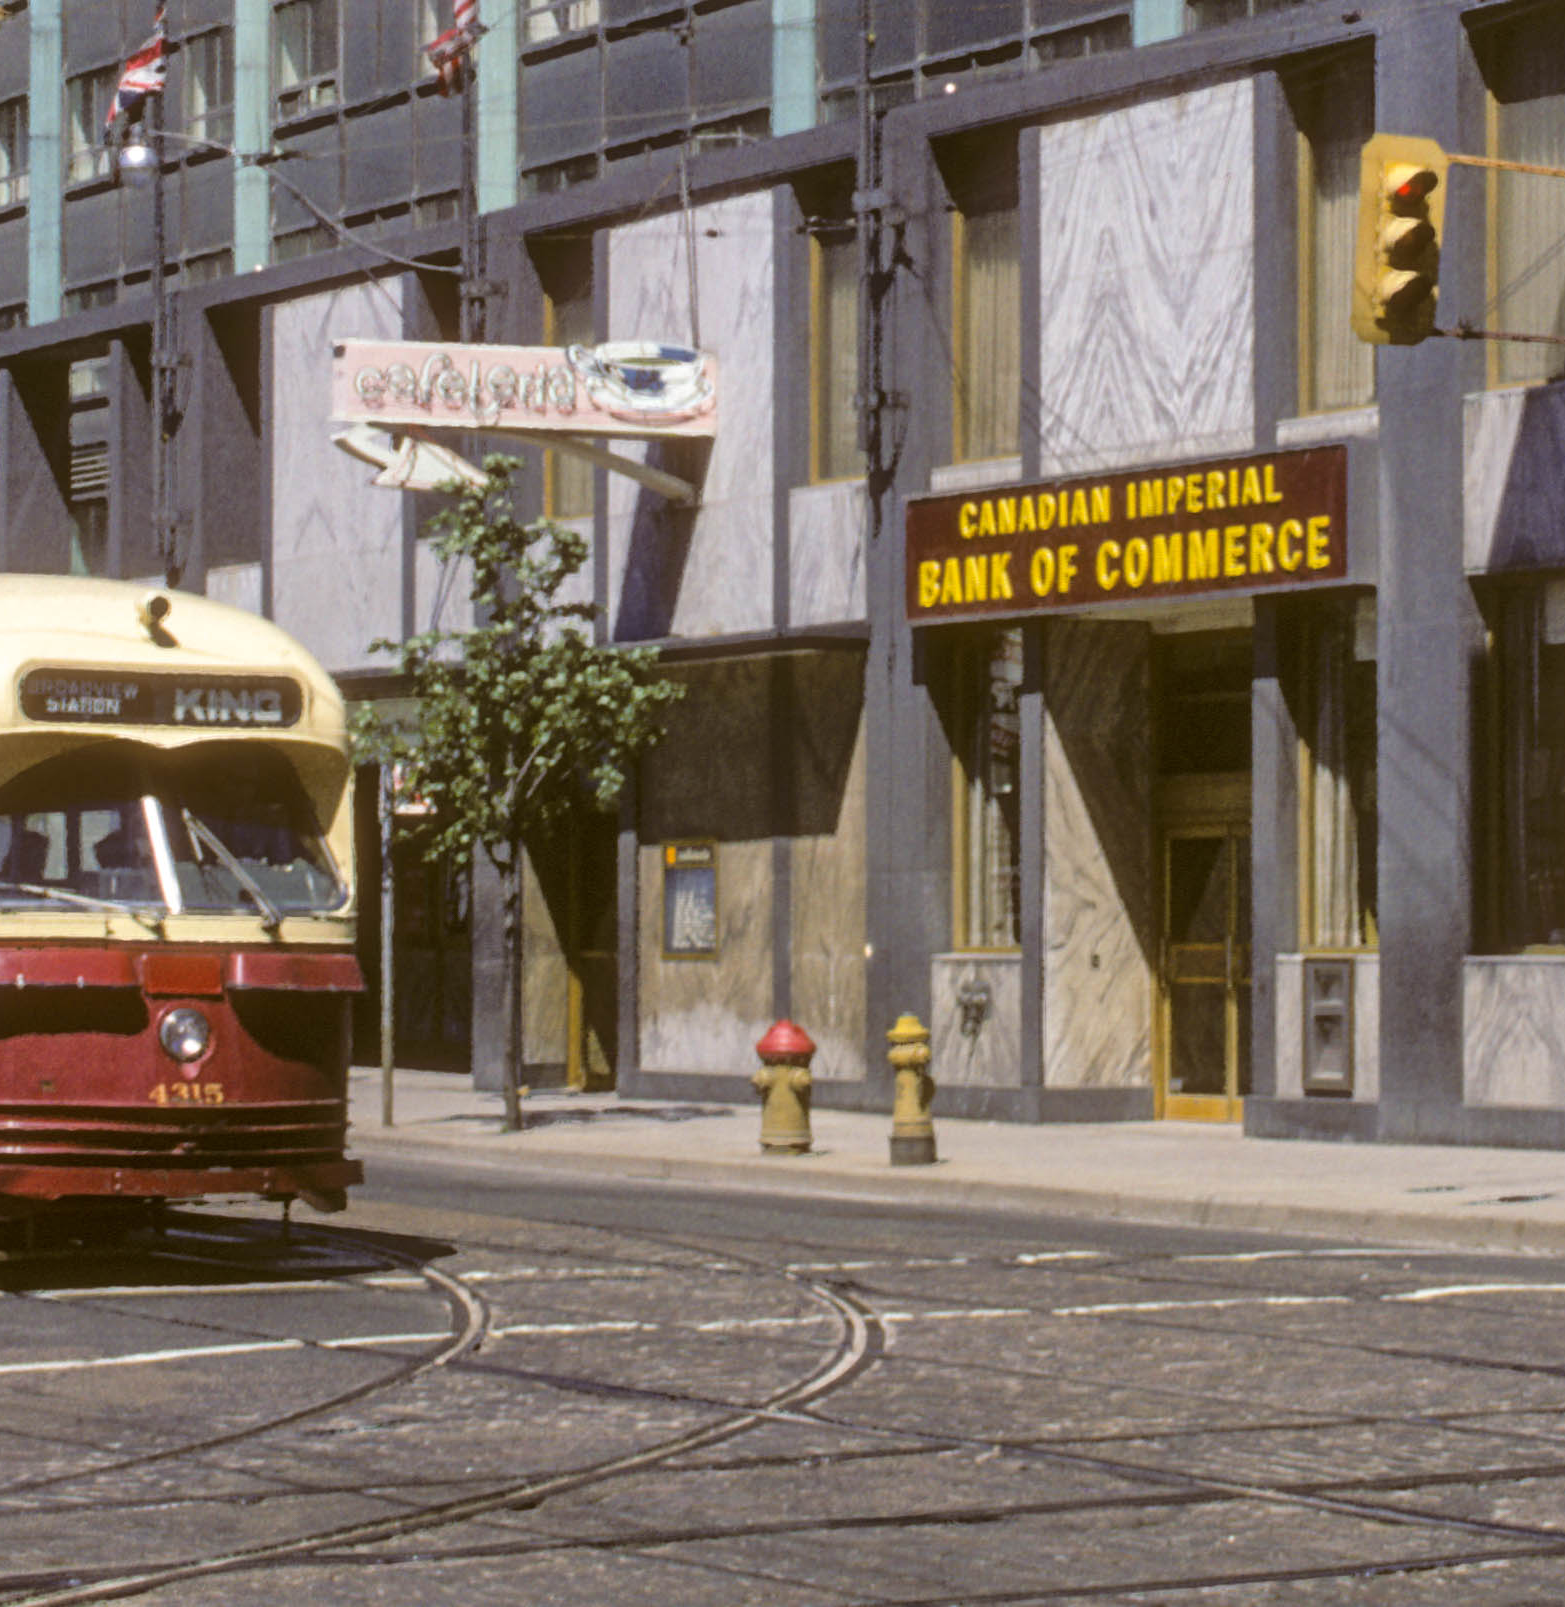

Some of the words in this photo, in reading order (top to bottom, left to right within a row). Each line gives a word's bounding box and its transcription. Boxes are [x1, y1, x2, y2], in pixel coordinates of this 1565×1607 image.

[355, 353, 576, 422] cafeteria
[958, 485, 1111, 540] CANADIAN
[1126, 464, 1283, 521] IMPERIAL
[918, 552, 1014, 608] BANK
[1030, 544, 1079, 598] OF
[1095, 515, 1332, 591] COMMERCE
[172, 688, 283, 722] KING
[148, 1081, 223, 1105] 4315
